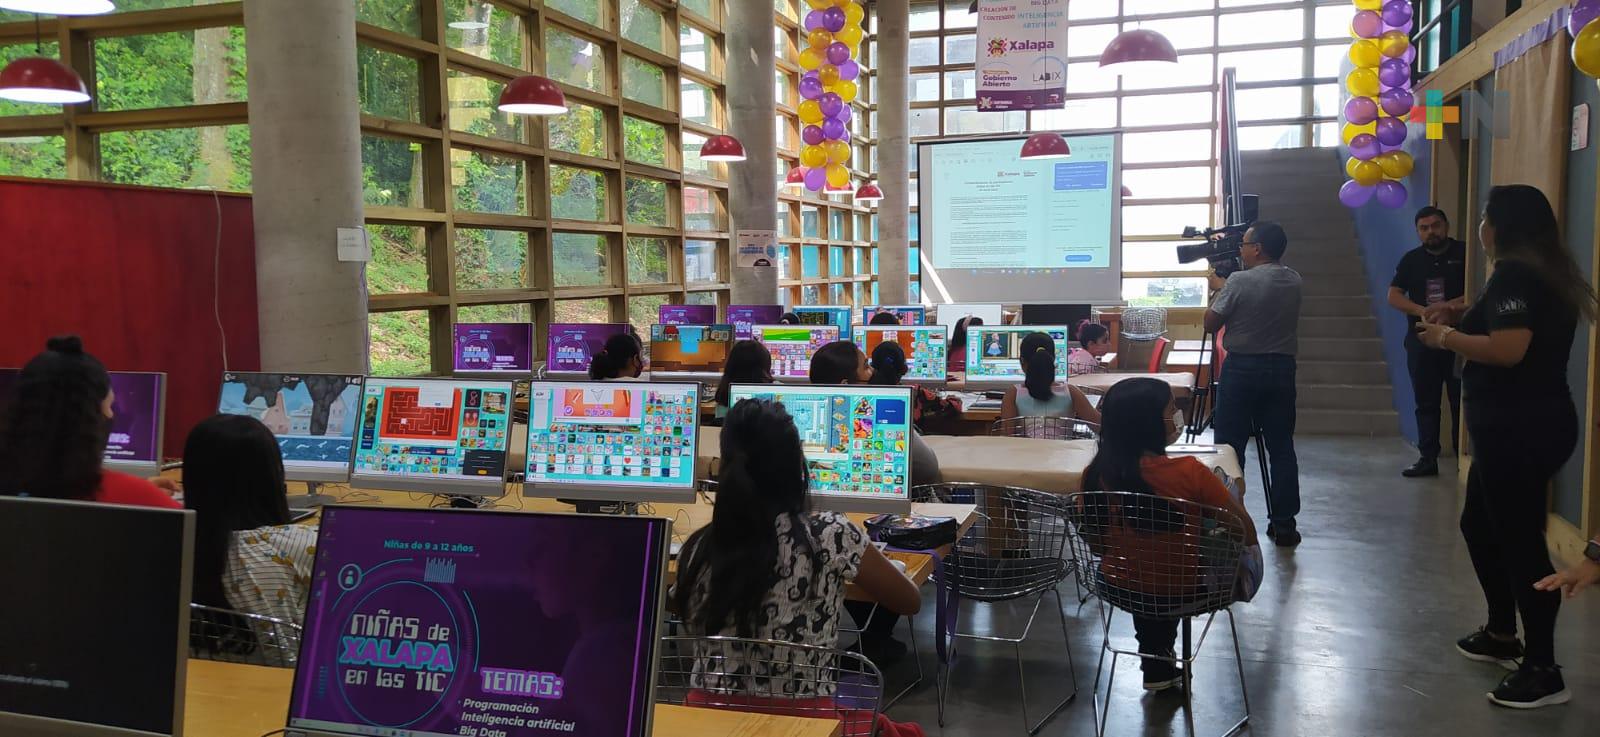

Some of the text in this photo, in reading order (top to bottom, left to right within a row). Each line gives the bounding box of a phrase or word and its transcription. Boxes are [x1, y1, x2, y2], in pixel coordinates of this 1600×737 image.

[1009, 40, 1055, 52] Xalapa
[1032, 72, 1062, 82] LABIX
[384, 539, 474, 552] Niñas de 9 a 12 años
[350, 609, 450, 641] NIÑAS de
[339, 636, 454, 672] XALAPA
[344, 668, 447, 692] en las TIC
[481, 669, 562, 697] TEMAS:
[463, 698, 540, 715] Programación
[459, 725, 507, 737] Big Data
[460, 711, 576, 732] Inteligencia artificial
